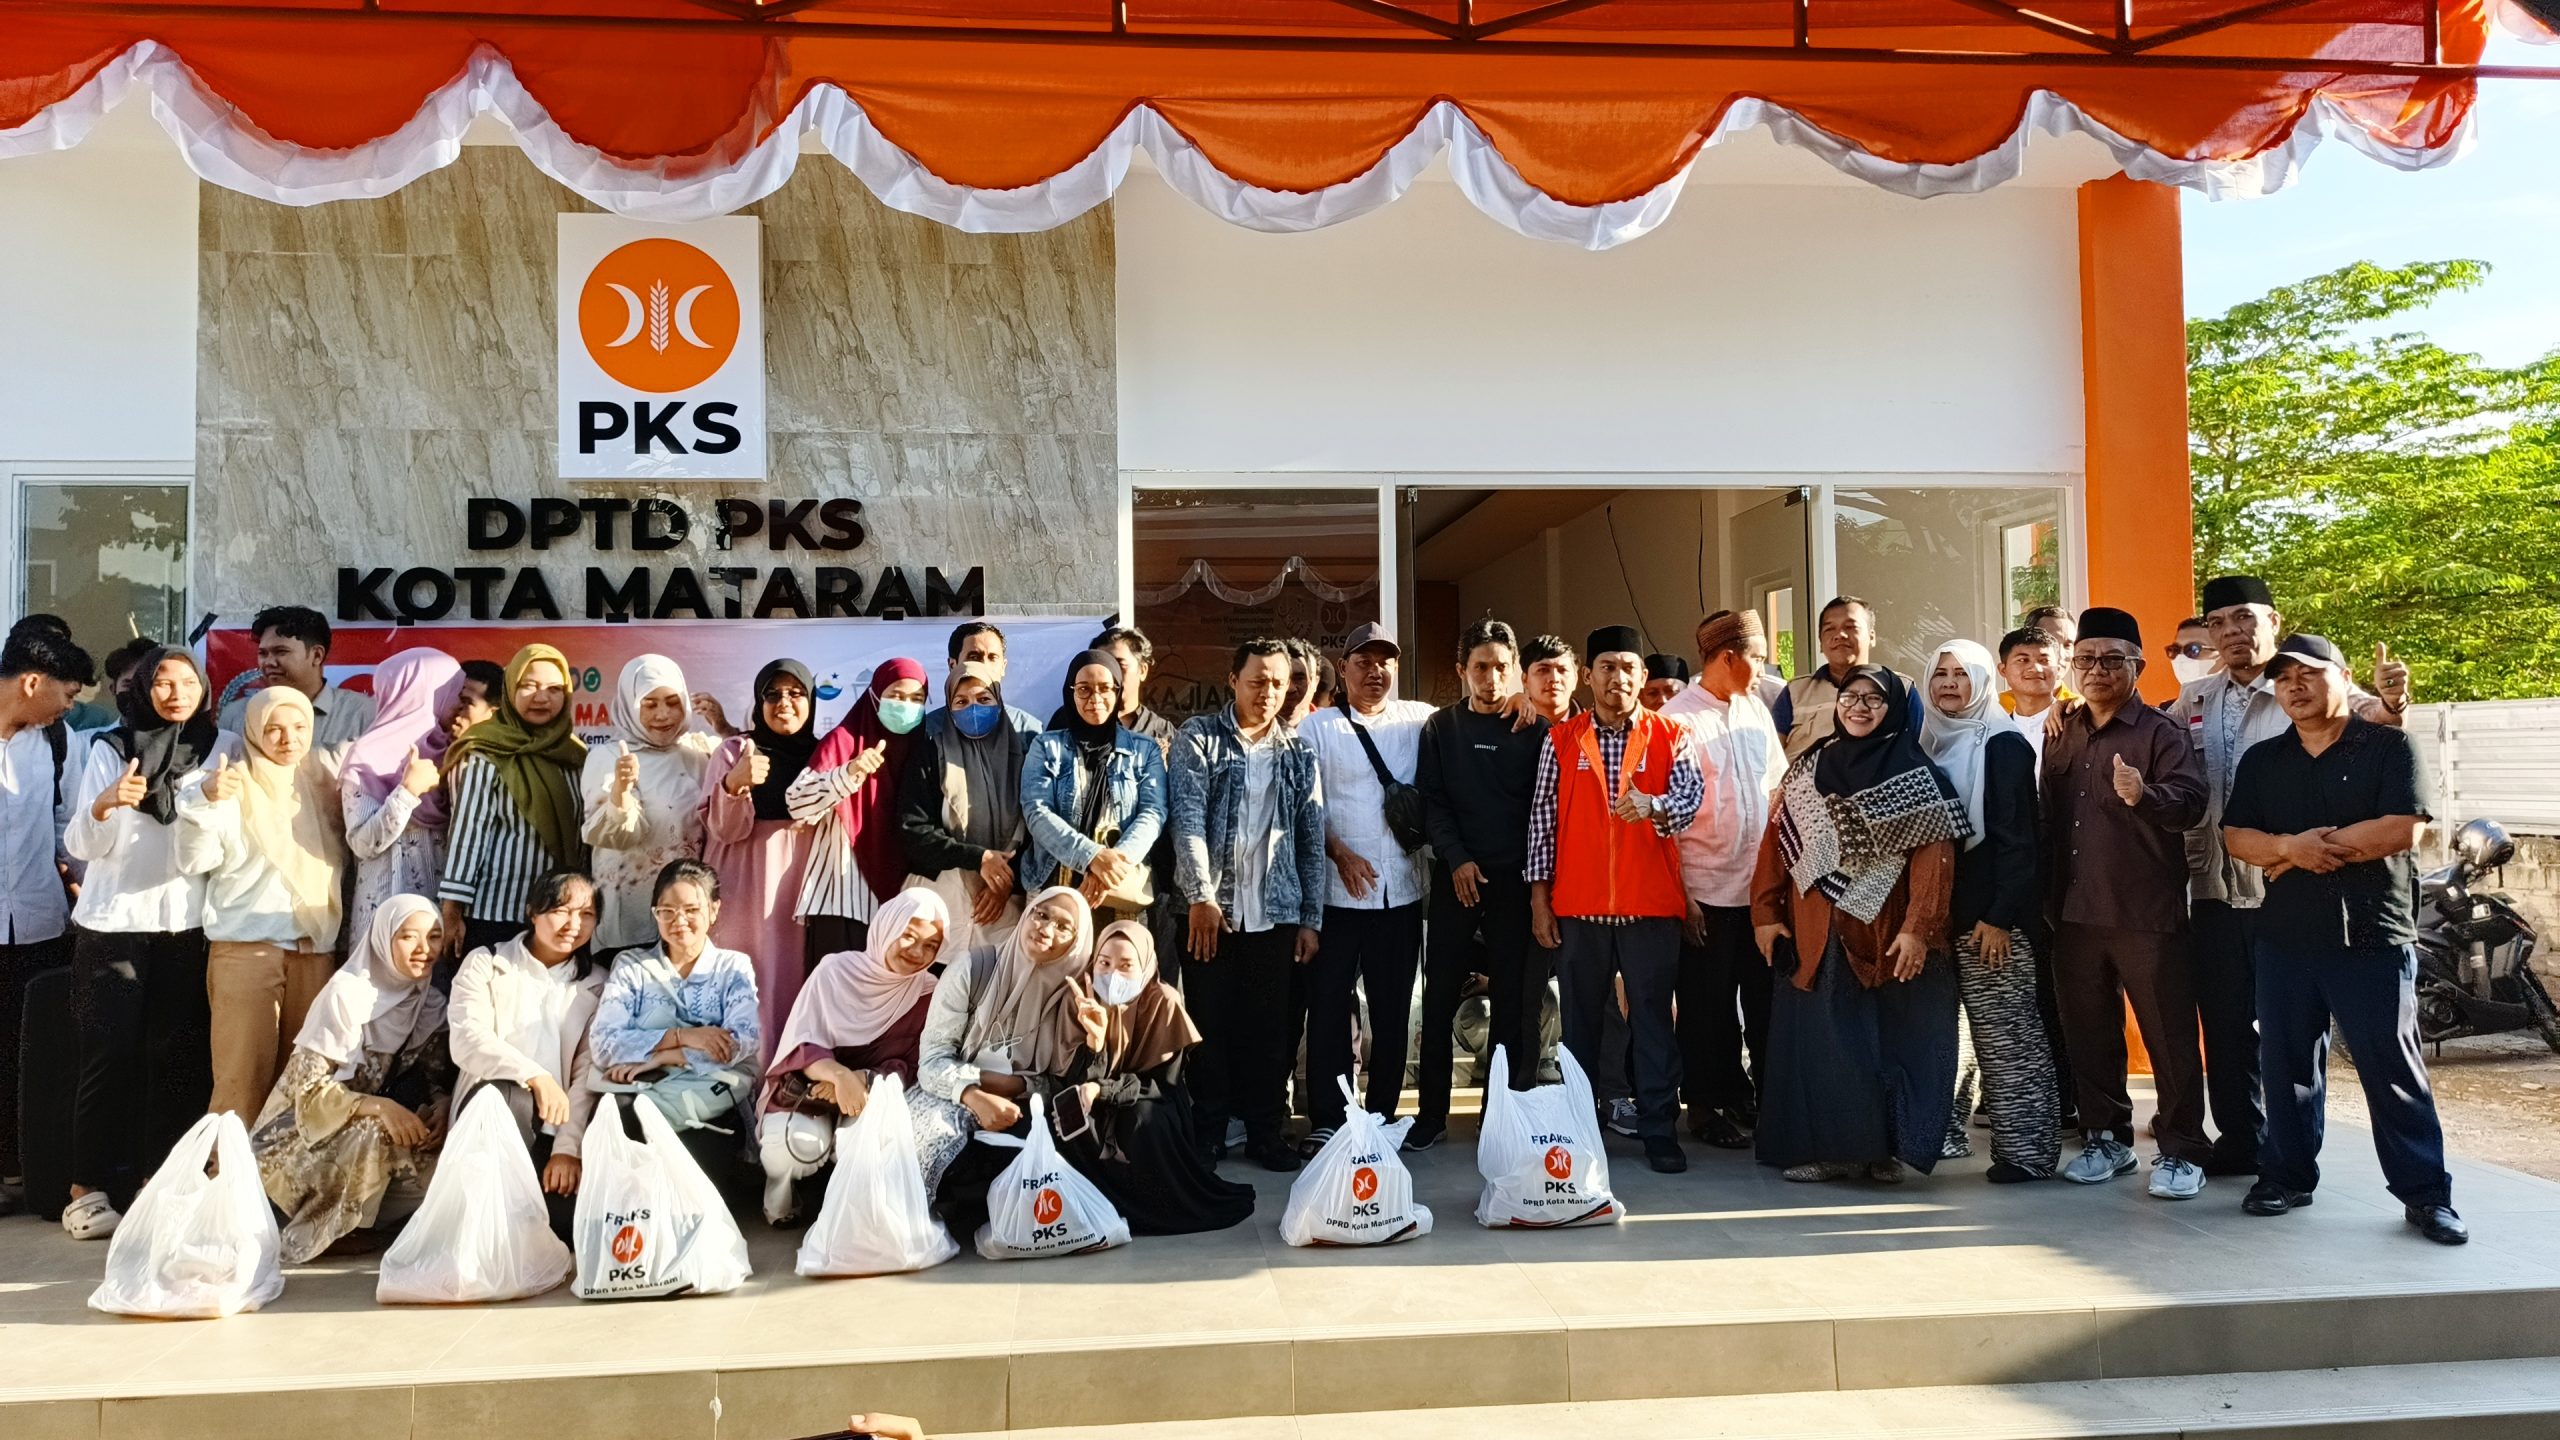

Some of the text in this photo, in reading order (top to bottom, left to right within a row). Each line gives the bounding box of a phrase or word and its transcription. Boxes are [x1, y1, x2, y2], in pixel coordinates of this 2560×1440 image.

[579, 401, 742, 455] PKS
[467, 498, 865, 552] DPTD PKS
[337, 566, 986, 621] KOTA MATARAM
[1531, 1133, 1574, 1145] FRAKSI
[1544, 1181, 1577, 1194] PKS
[1352, 1202, 1380, 1218] PKS
[1522, 1198, 1545, 1207] DPRD
[1546, 1198, 1565, 1206] Kota
[1326, 1215, 1404, 1231] DPRD Kota Mataram
[1032, 1222, 1068, 1244] PKS
[1058, 1232, 1096, 1247] Mataram
[608, 1265, 646, 1282] PKS
